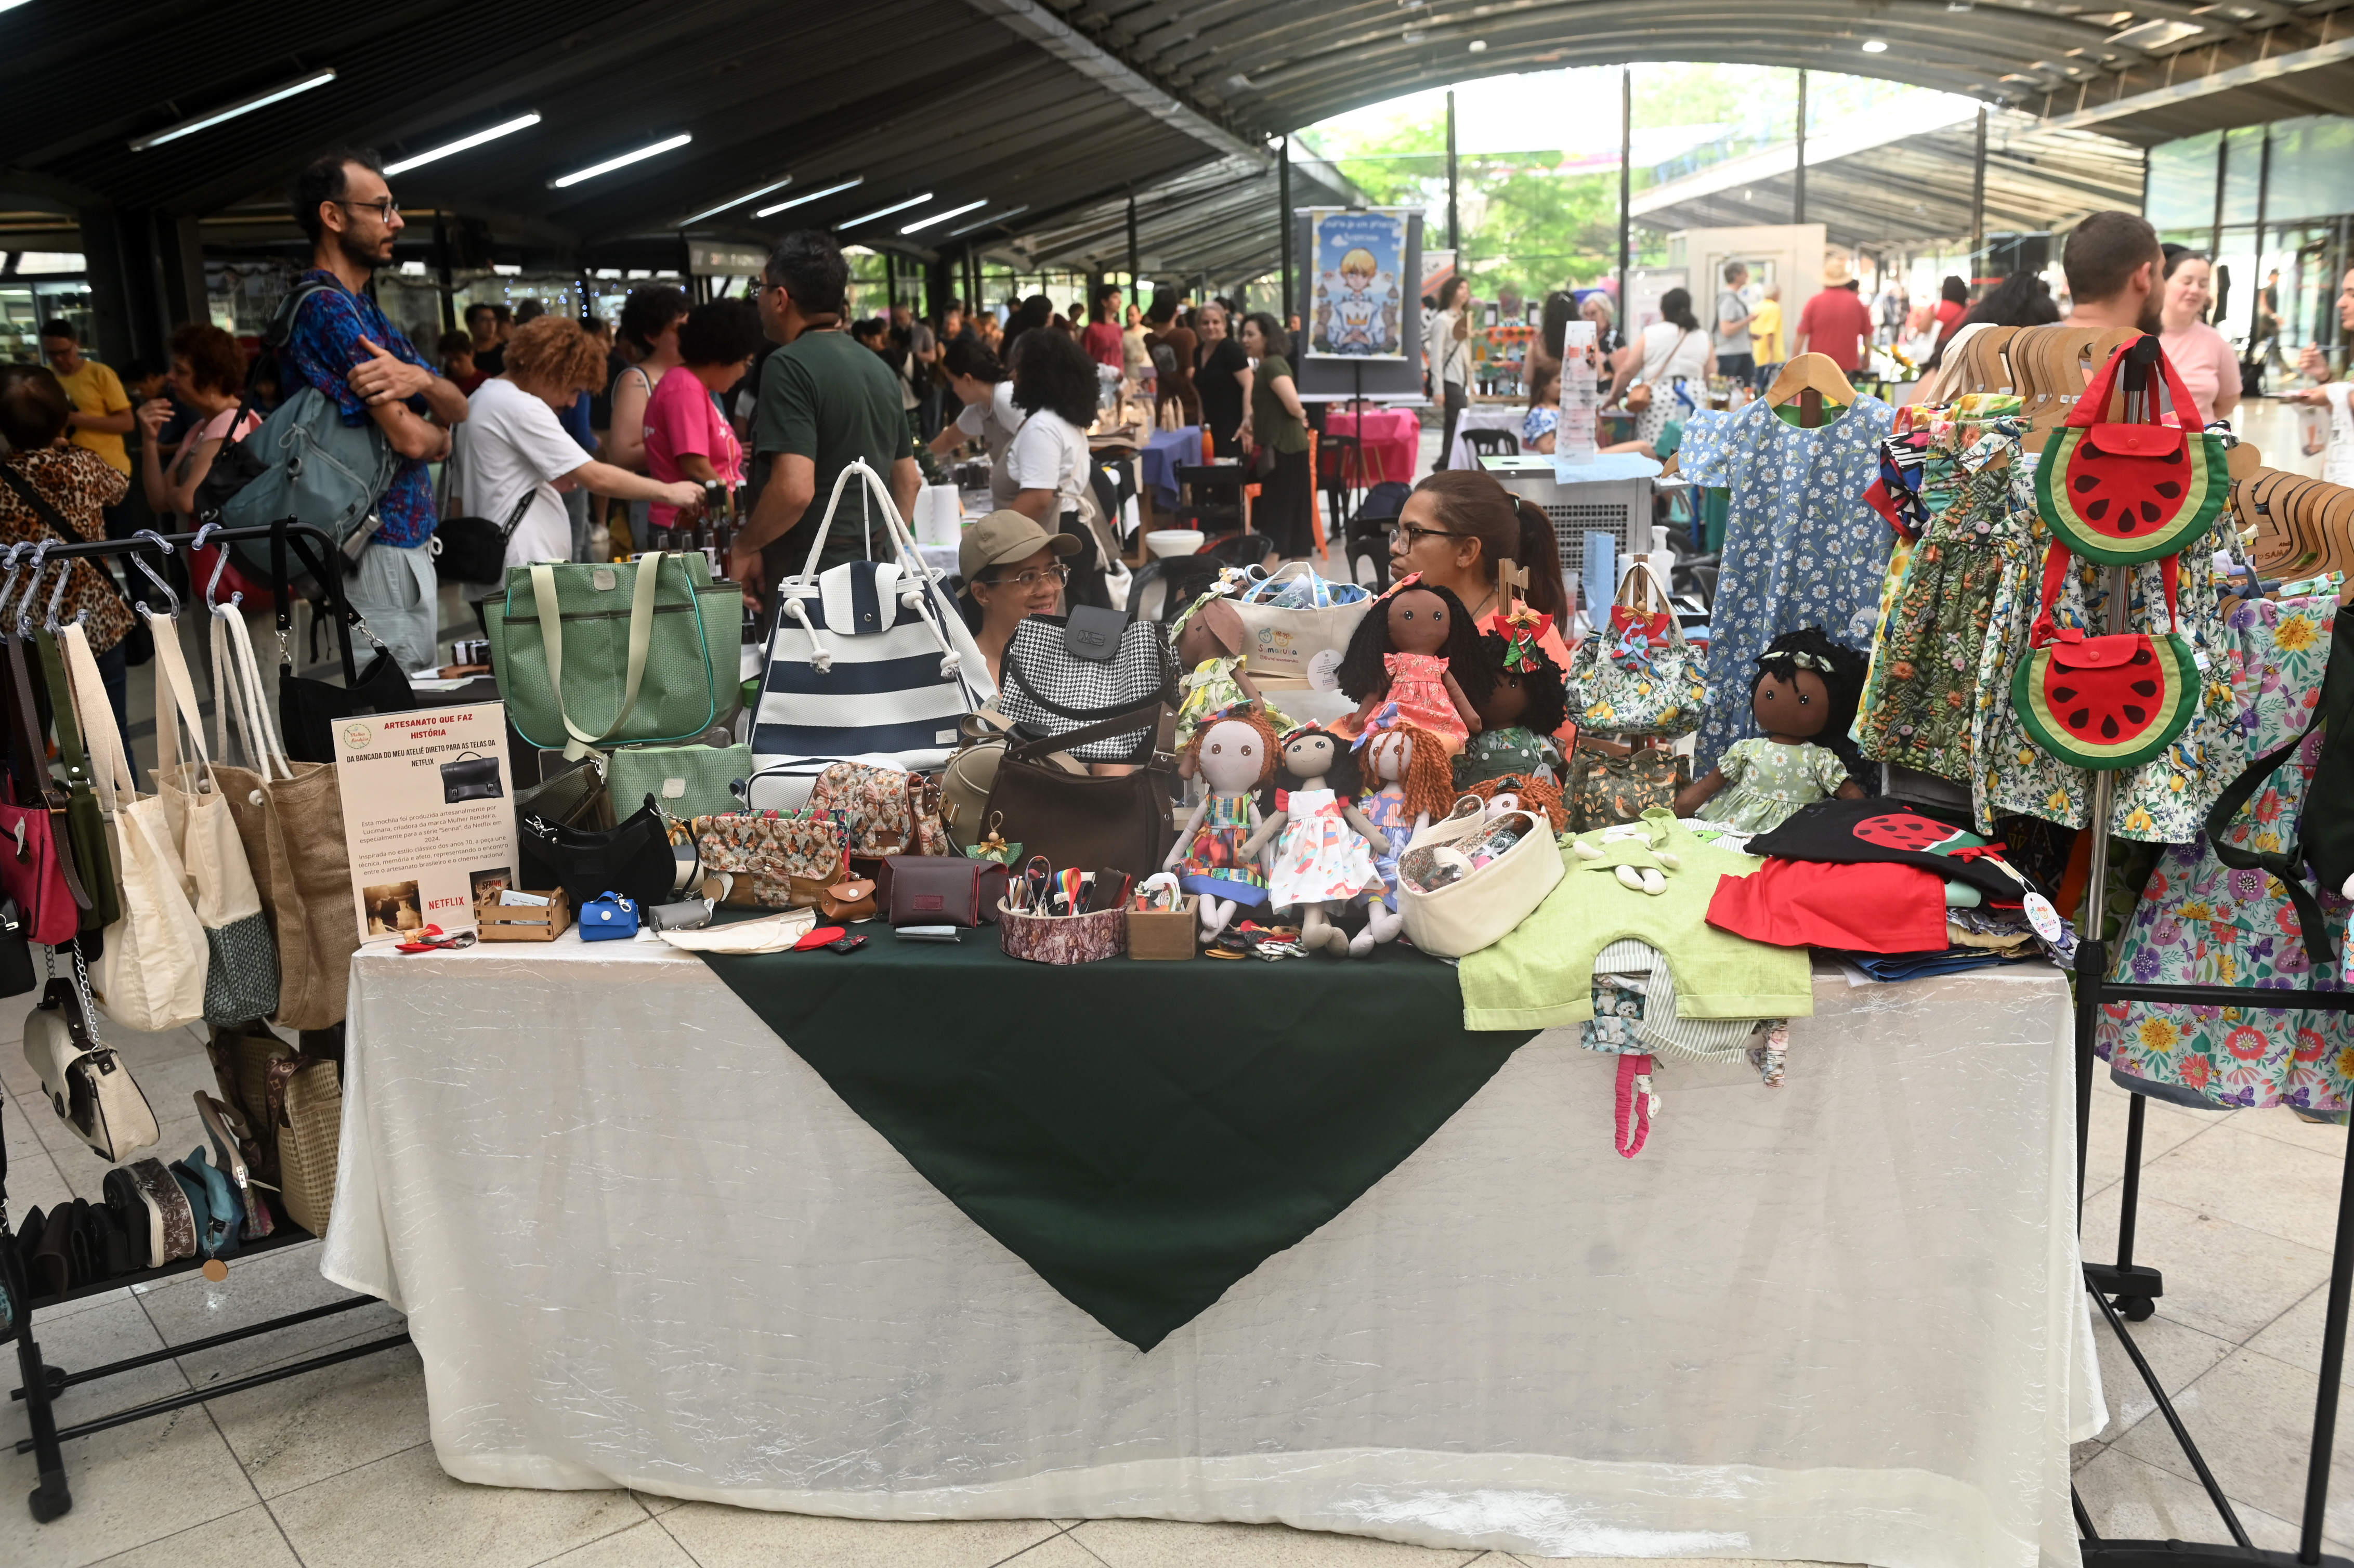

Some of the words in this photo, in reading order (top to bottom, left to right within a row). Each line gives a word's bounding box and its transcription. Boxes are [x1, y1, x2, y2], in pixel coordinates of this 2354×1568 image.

[384, 718, 437, 729] ARTESANATO
[439, 715, 454, 724] QUE
[411, 728, 446, 739] HISTÓRIA
[356, 752, 383, 762] BANCADA
[406, 747, 424, 756] ATELIÊ
[425, 745, 444, 754] DIRETO
[446, 743, 461, 751] PARA
[470, 740, 487, 749] TELAS
[411, 759, 434, 767] NETFLIX
[409, 813, 438, 821] produzida
[440, 807, 485, 816] artesanalmente
[360, 834, 402, 843] especialmente
[359, 852, 386, 860] Inspirada
[434, 847, 476, 858] representando
[428, 896, 464, 910] NETFLIX
